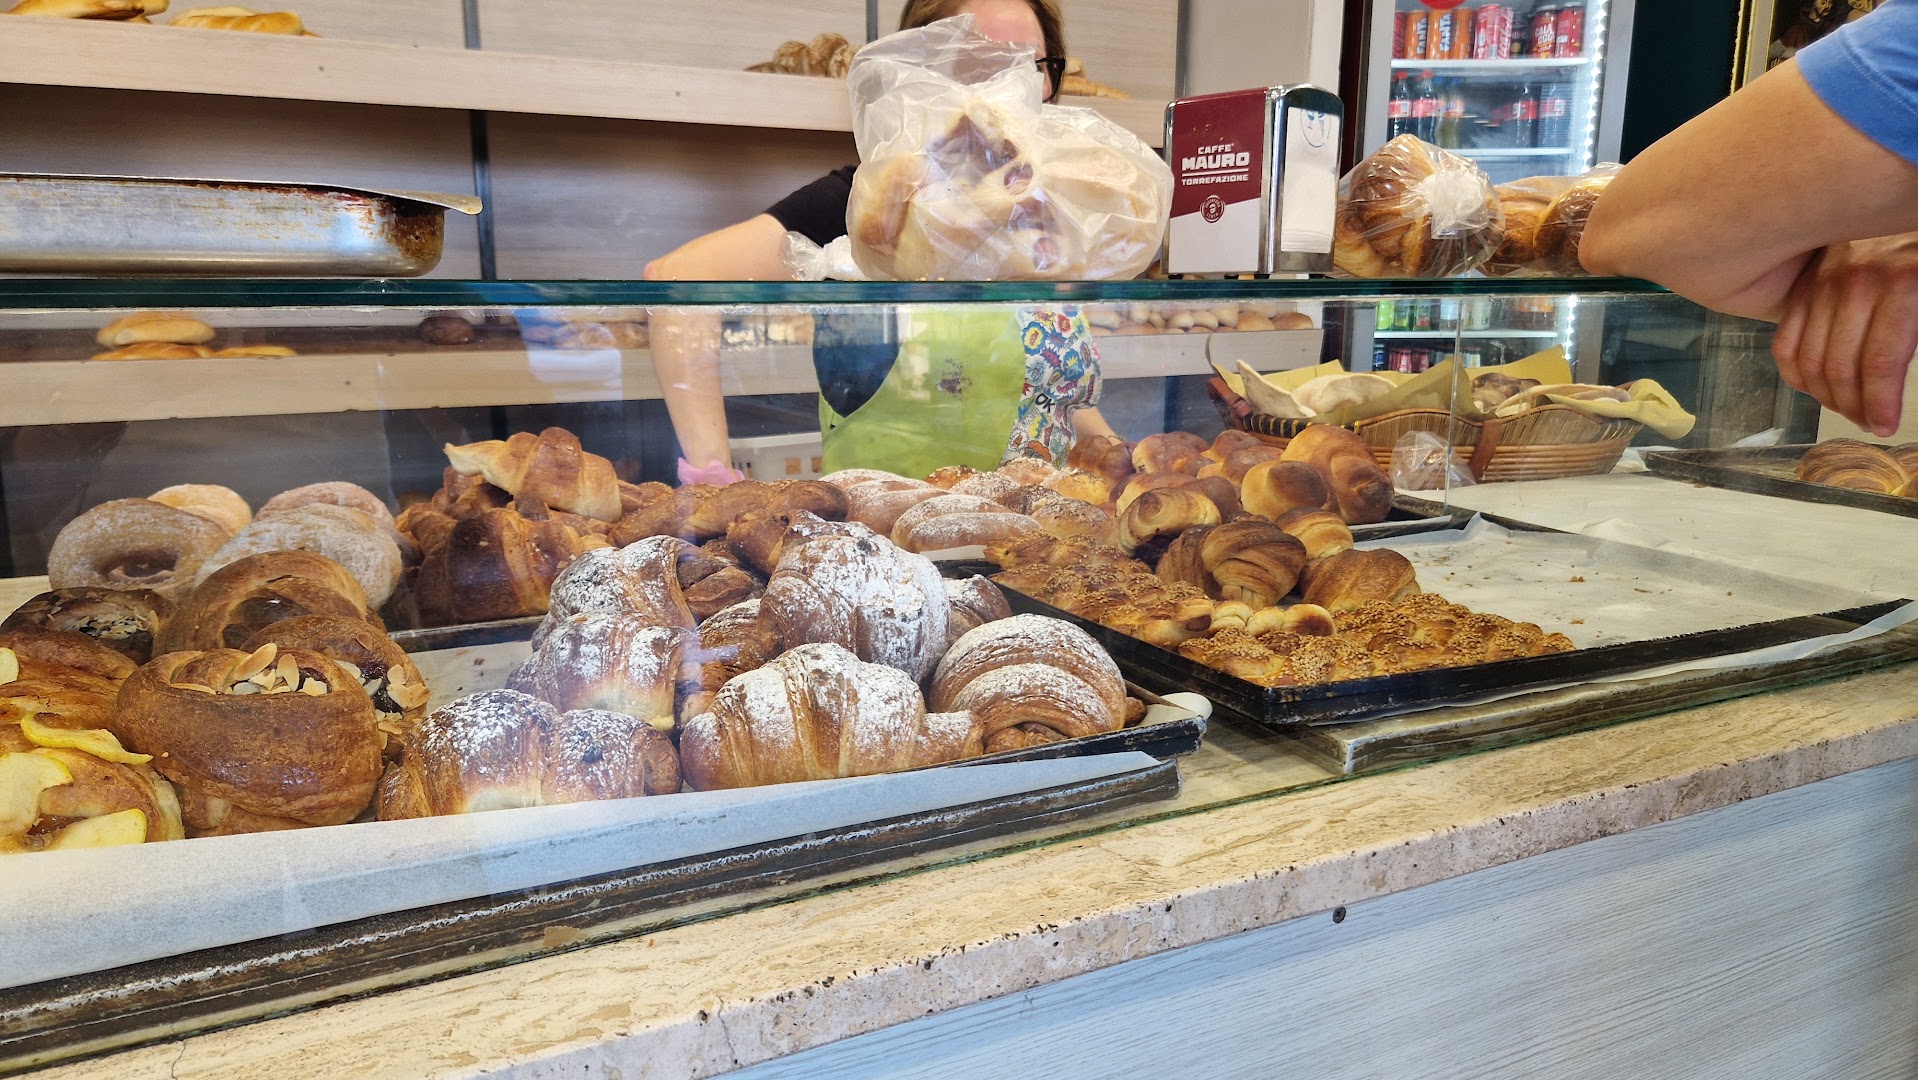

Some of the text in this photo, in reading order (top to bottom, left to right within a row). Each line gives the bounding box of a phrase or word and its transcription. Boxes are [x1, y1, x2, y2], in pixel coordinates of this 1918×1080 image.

[1182, 152, 1250, 171] MAURO
[1182, 174, 1249, 186] TORREFAZIONE
[1034, 393, 1055, 413] OK
